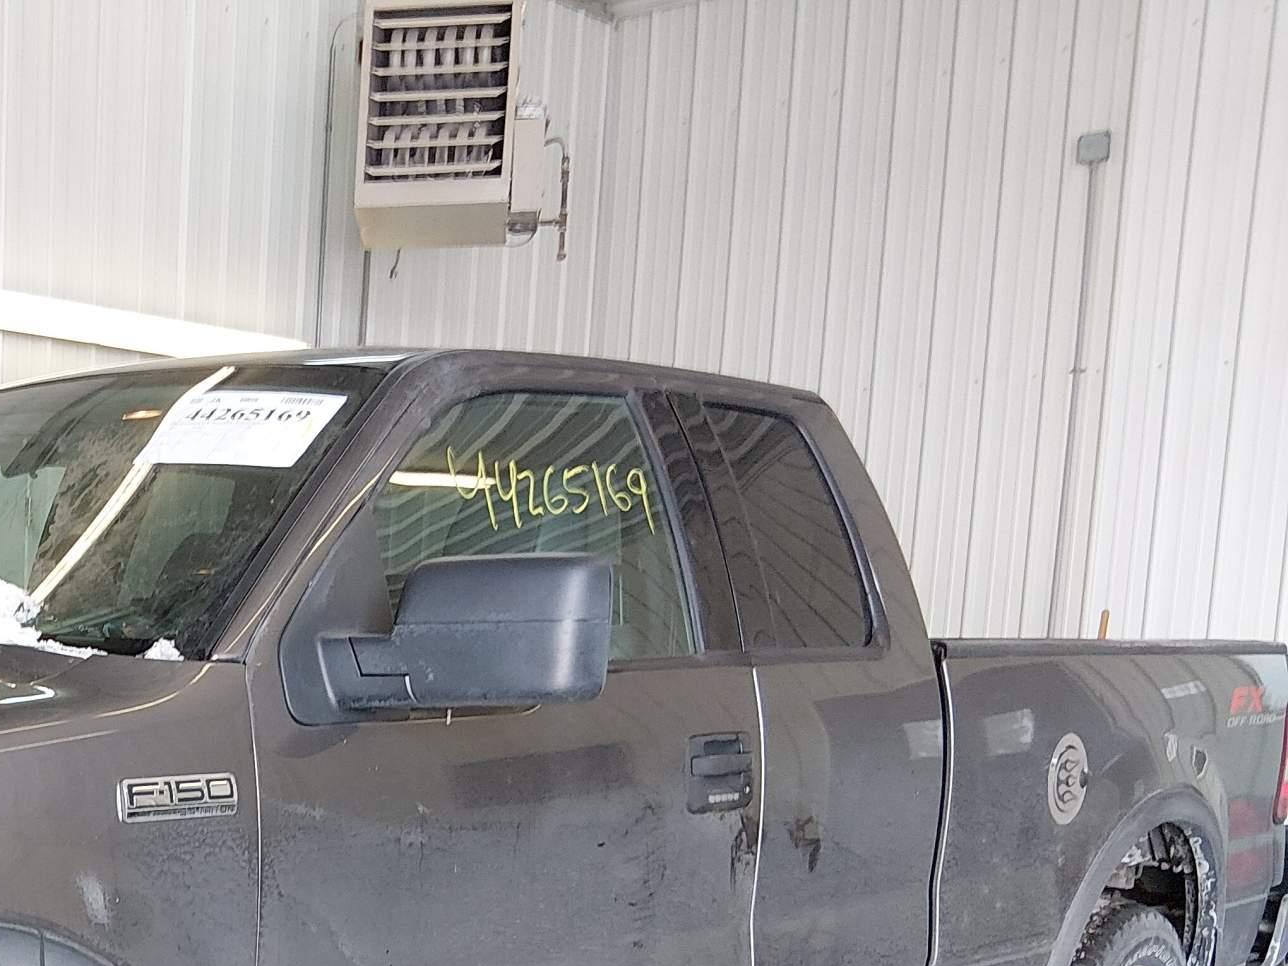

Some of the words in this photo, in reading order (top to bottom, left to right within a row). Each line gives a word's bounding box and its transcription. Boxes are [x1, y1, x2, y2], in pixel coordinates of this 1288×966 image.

[186, 407, 312, 422] 44265169
[446, 446, 656, 536] 44265169
[127, 778, 234, 808] F-150
